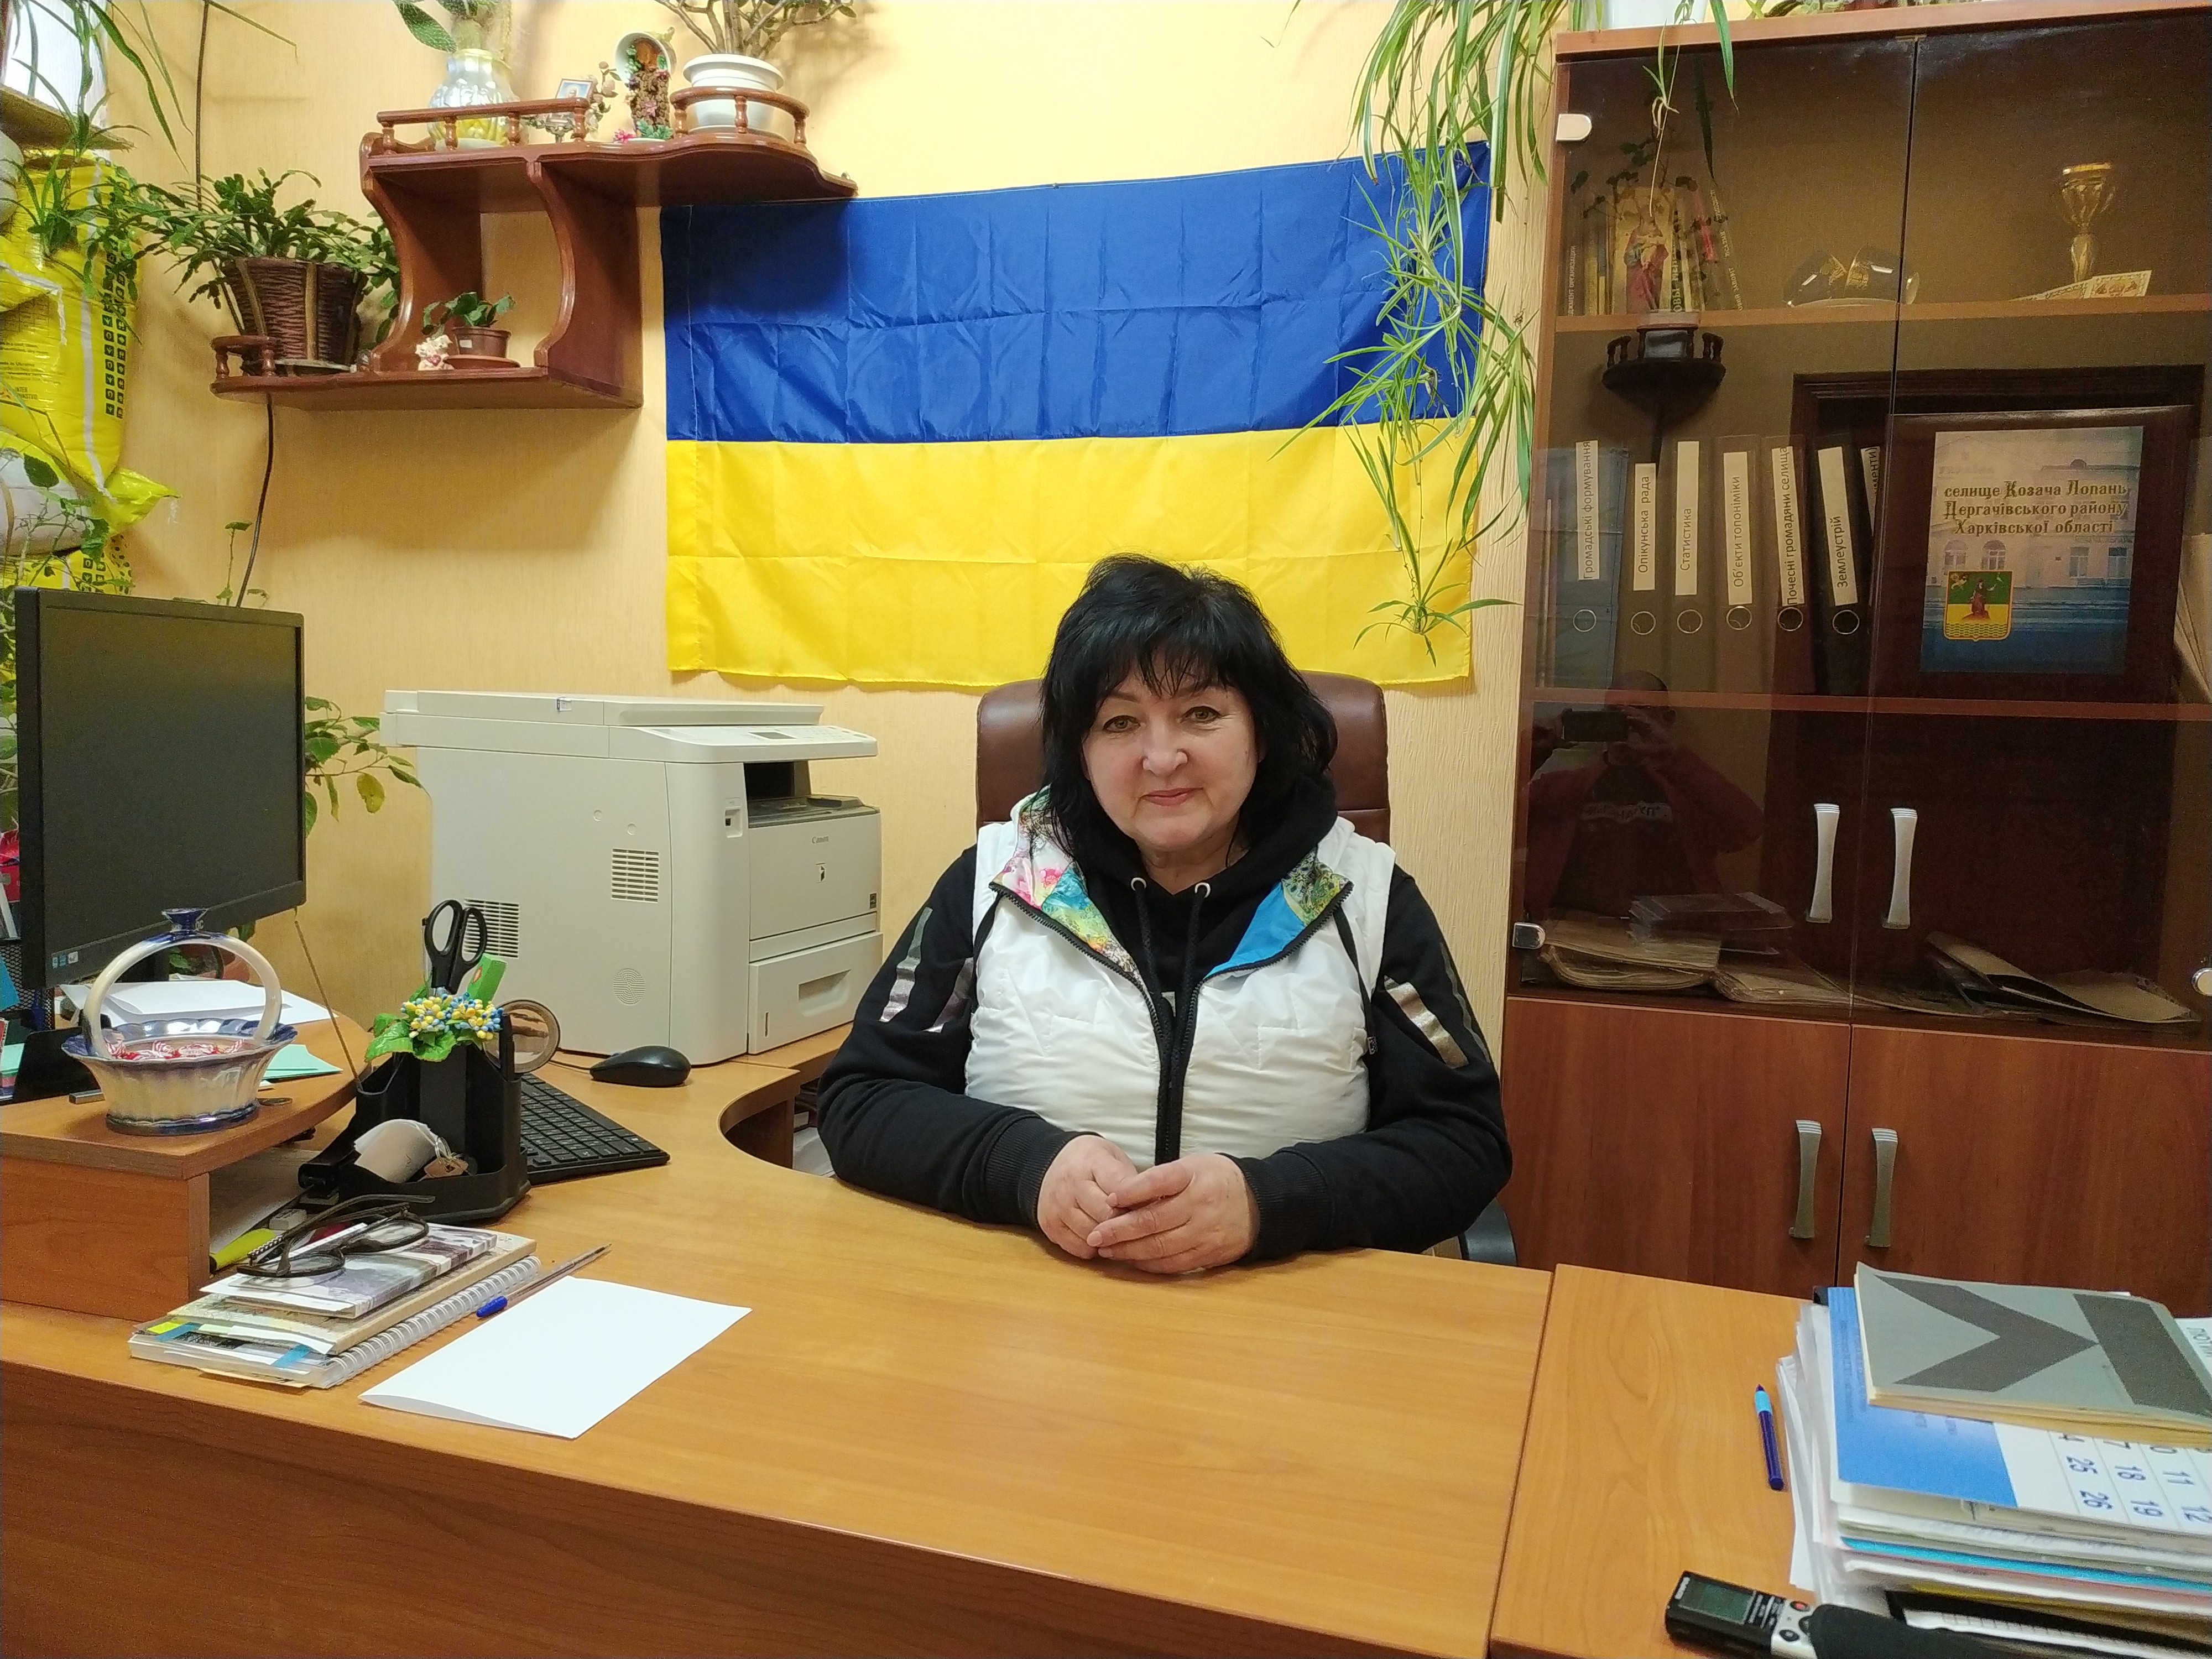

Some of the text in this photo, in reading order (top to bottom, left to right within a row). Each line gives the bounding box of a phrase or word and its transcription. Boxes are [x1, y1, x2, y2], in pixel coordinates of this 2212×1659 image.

[1944, 479, 2128, 499] селище Козача Лопань
[1582, 441, 1596, 580] Громадські формування
[1637, 476, 1651, 573] Опікунська рада
[1731, 476, 1743, 540] топоніміки
[1778, 447, 1798, 606] Почесні громадяни селища
[1943, 500, 2127, 520] Дергачівського району
[1679, 508, 1692, 571] Статистика
[1954, 520, 2114, 537] Харківської області
[1830, 515, 1848, 589] Землеустрій
[2066, 1455, 2099, 1475] 25
[2114, 1465, 2147, 1481] 18
[2079, 1490, 2114, 1510] 26
[2130, 1500, 2163, 1517] 19
[2162, 1470, 2195, 1485] 11
[2181, 1505, 2212, 1525] 12
